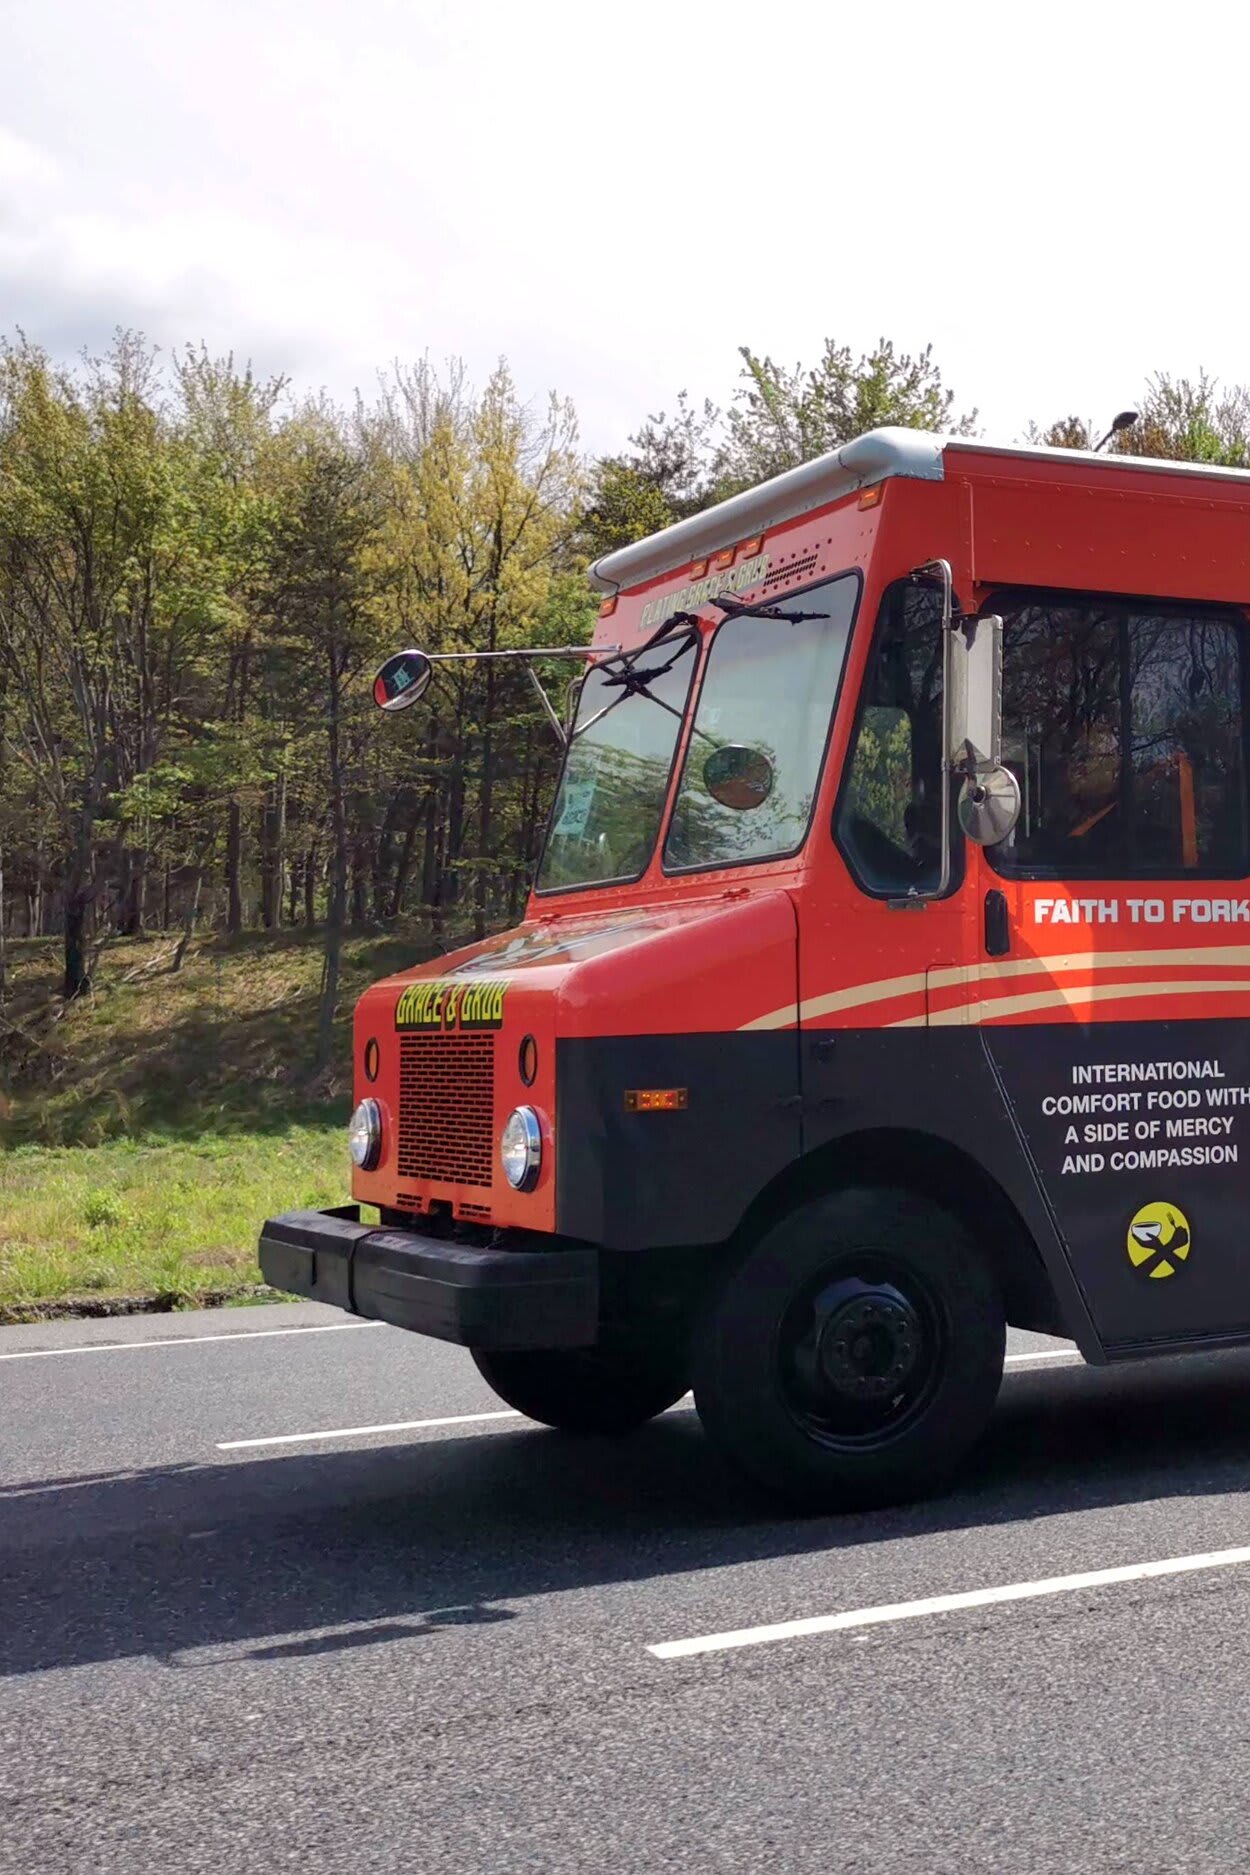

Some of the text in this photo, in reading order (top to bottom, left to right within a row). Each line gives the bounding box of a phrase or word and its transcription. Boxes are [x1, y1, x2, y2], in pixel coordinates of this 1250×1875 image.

[1034, 898, 1250, 924] FAITH TO FORK
[397, 982, 451, 1024] GRACE
[461, 979, 512, 1021] GRUB
[1072, 1060, 1225, 1084] INTERNATIONAL
[1041, 1092, 1141, 1116] COMFORT
[1147, 1089, 1201, 1111] FOOD
[1065, 1116, 1234, 1144] A SIDE OF MERCY
[1061, 1145, 1238, 1174] AND COMPASSION
